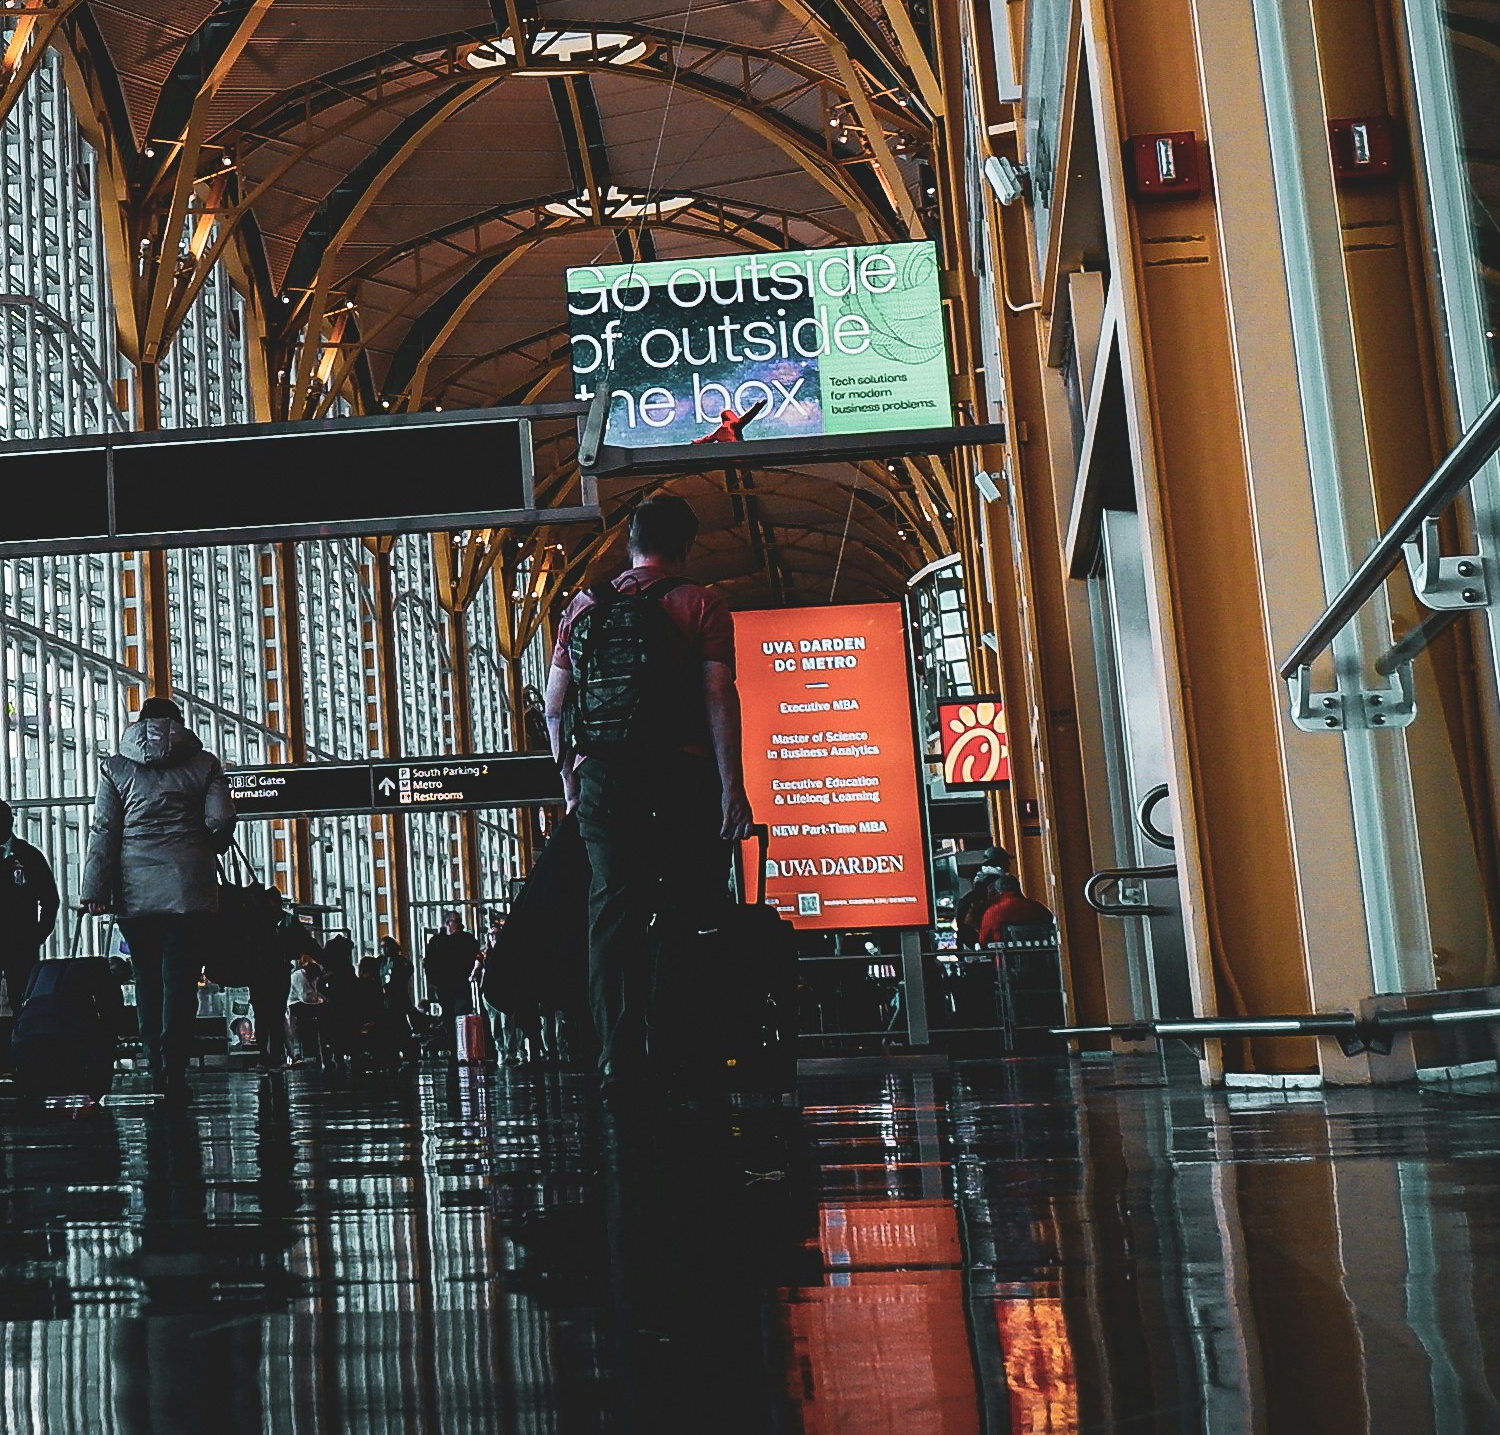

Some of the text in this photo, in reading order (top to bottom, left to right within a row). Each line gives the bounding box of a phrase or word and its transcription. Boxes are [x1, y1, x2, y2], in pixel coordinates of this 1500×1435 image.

[568, 248, 898, 315] Go outside
[571, 305, 871, 374] of outside
[829, 373, 908, 386] Tech solutions
[693, 373, 809, 426] box
[830, 391, 846, 400] for
[831, 403, 880, 414] business
[762, 636, 866, 655] UVA DARDEN
[774, 655, 857, 672] DC METRO
[779, 699, 860, 713] Executive MBA
[772, 731, 868, 745] Master of Science
[780, 748, 829, 759] Business
[830, 745, 880, 758] Analytics
[412, 767, 441, 778] South
[443, 766, 480, 777] Parking
[481, 764, 489, 775] 2
[259, 776, 286, 786] Gates
[412, 780, 443, 789] Metro
[772, 776, 879, 791] Executive Education
[230, 788, 279, 799] formation
[413, 791, 464, 802] Restrooms
[786, 793, 830, 805] Lifelong
[832, 790, 881, 803] Learning
[772, 825, 799, 836] NEW
[858, 821, 888, 833] MBA
[779, 855, 904, 877] UVA DARDEN
